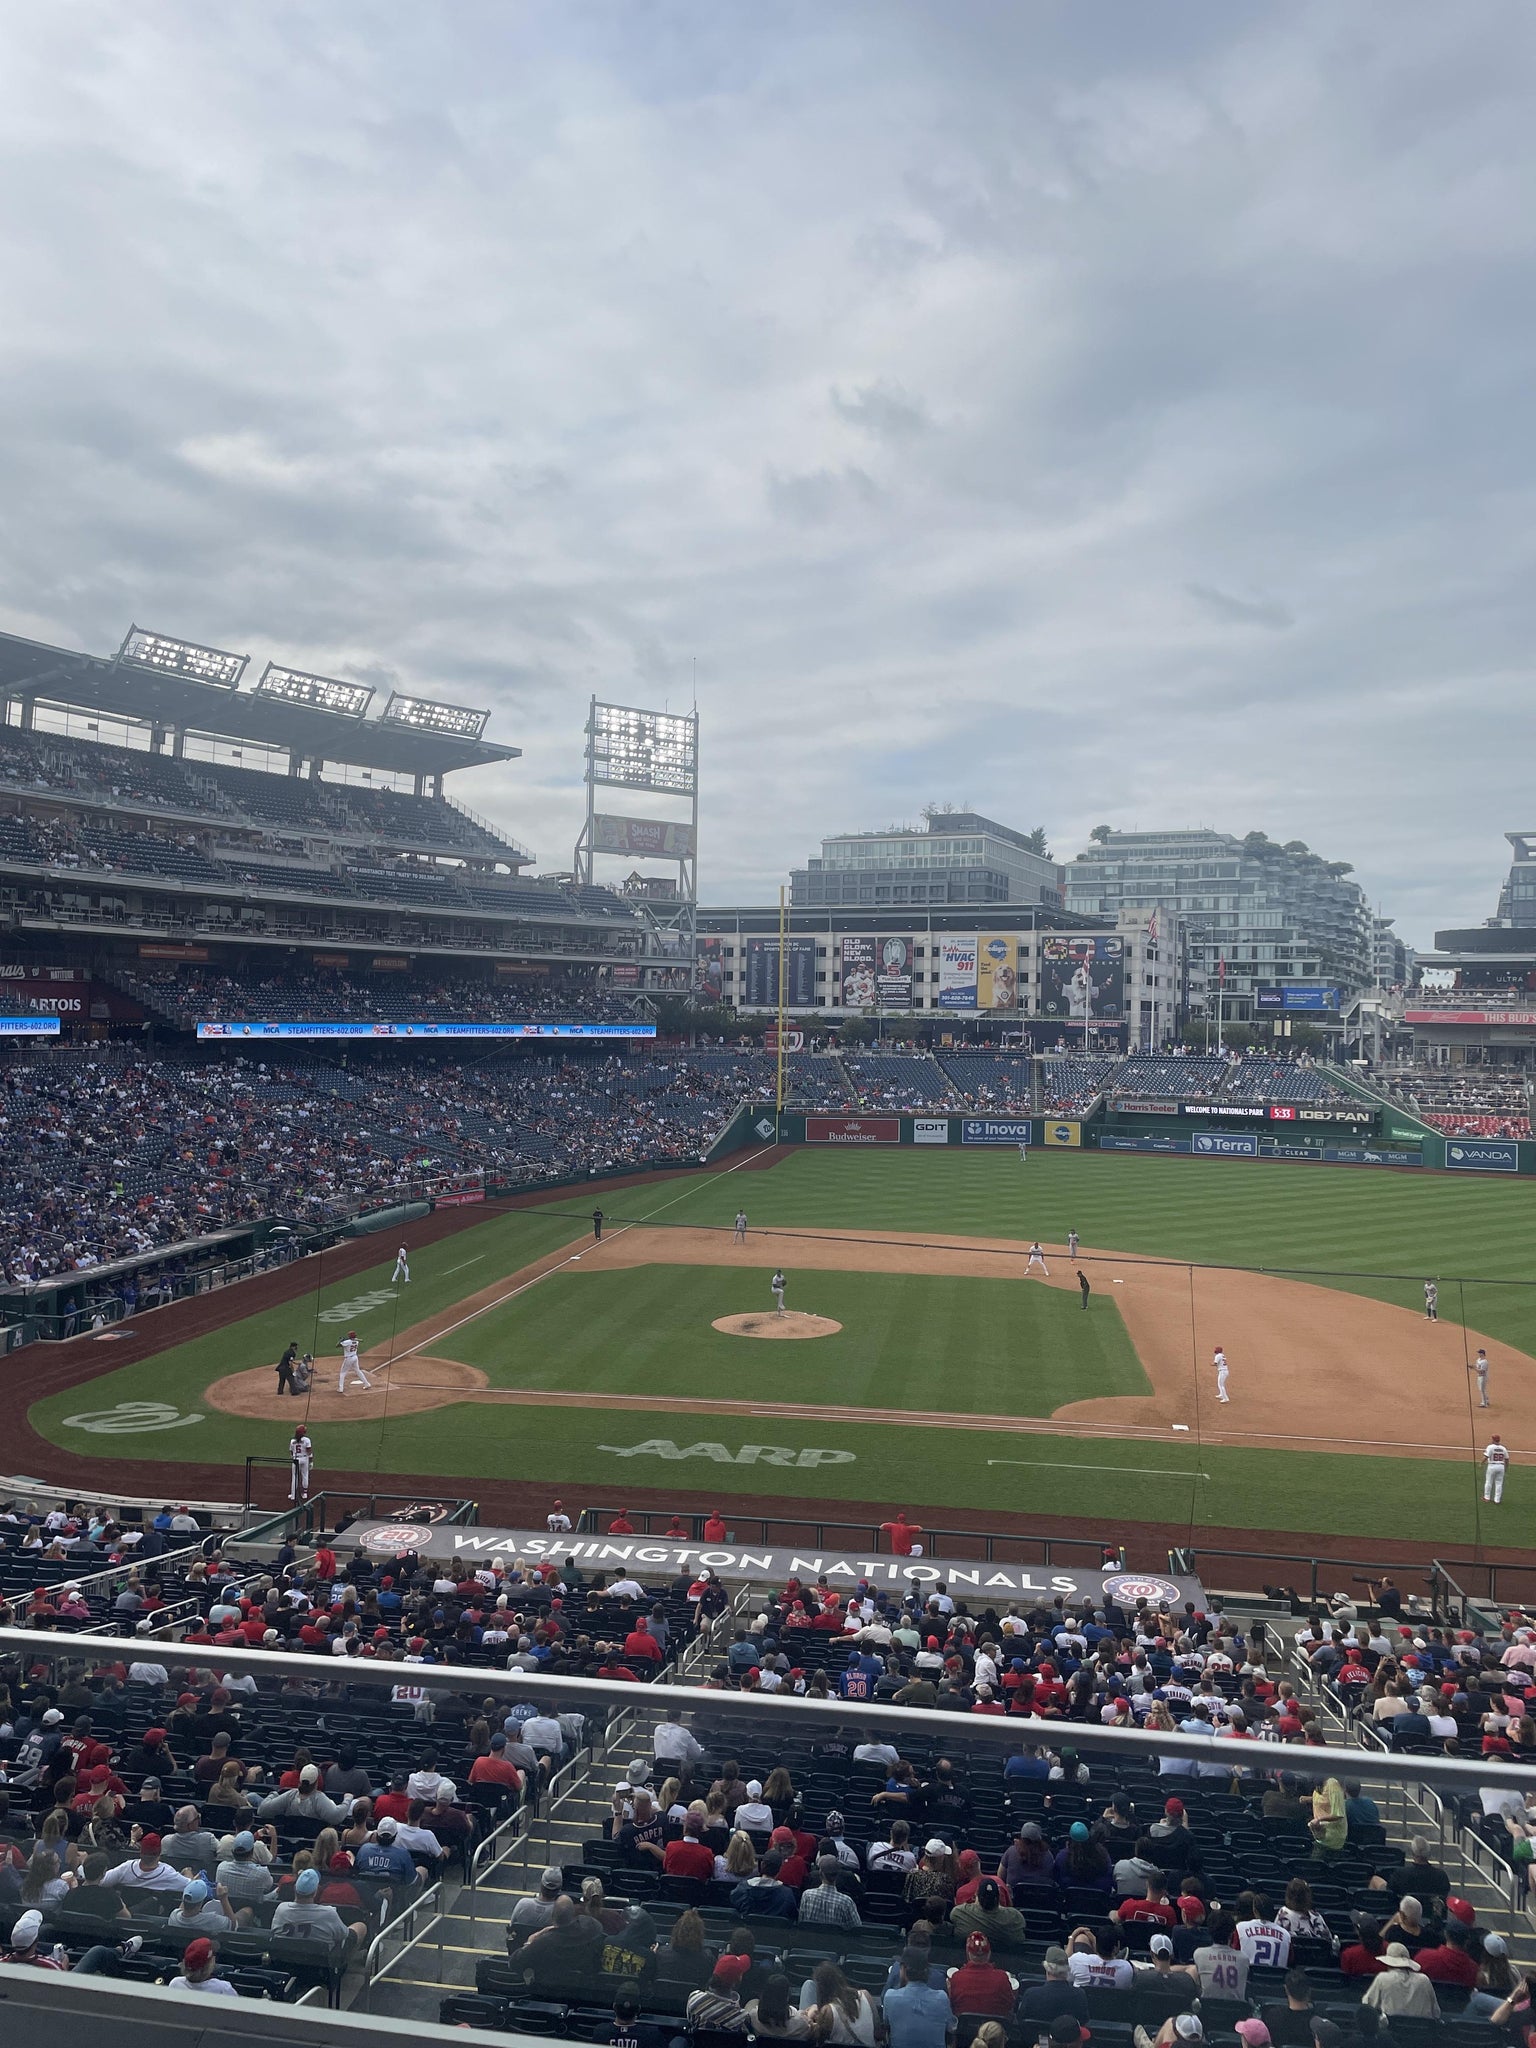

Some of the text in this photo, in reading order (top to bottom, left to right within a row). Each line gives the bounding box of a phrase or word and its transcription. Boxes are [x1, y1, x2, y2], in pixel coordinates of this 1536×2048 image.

[631, 824, 660, 840] SMASH
[946, 953, 975, 961] HVAC
[957, 962, 974, 971] 911
[30, 998, 81, 1011] ARTOIS
[1483, 1013, 1505, 1022] THIS
[288, 1026, 363, 1034] STEAMFITTERS-602.ORG
[590, 1027, 653, 1035] STEAMFITTERS-602.ORG
[1124, 1103, 1176, 1112] Harris Teeter
[1185, 1106, 1263, 1116] WELCOME TO NATIONALS PARK
[1274, 1108, 1291, 1118] 5:33
[1336, 1112, 1369, 1121] FAN
[916, 1123, 946, 1131] GDIT
[985, 1122, 1026, 1135] Inova
[829, 1132, 876, 1141] Budweiser
[1214, 1139, 1251, 1151] Terra
[1465, 1150, 1512, 1160] VANDA
[596, 1439, 857, 1468] AARP
[453, 1535, 772, 1570] WASHINGTON
[789, 1558, 1078, 1592] NATIONALS
[847, 1681, 866, 1697] 20
[16, 1745, 42, 1768] 29
[633, 1827, 663, 1843] HARPER
[368, 1856, 390, 1868] WOOD
[1245, 1926, 1284, 1942] CLEMENTE
[1254, 1940, 1280, 1966] 21
[1089, 1964, 1116, 1977] LINDOR
[1212, 1964, 1238, 1989] 48
